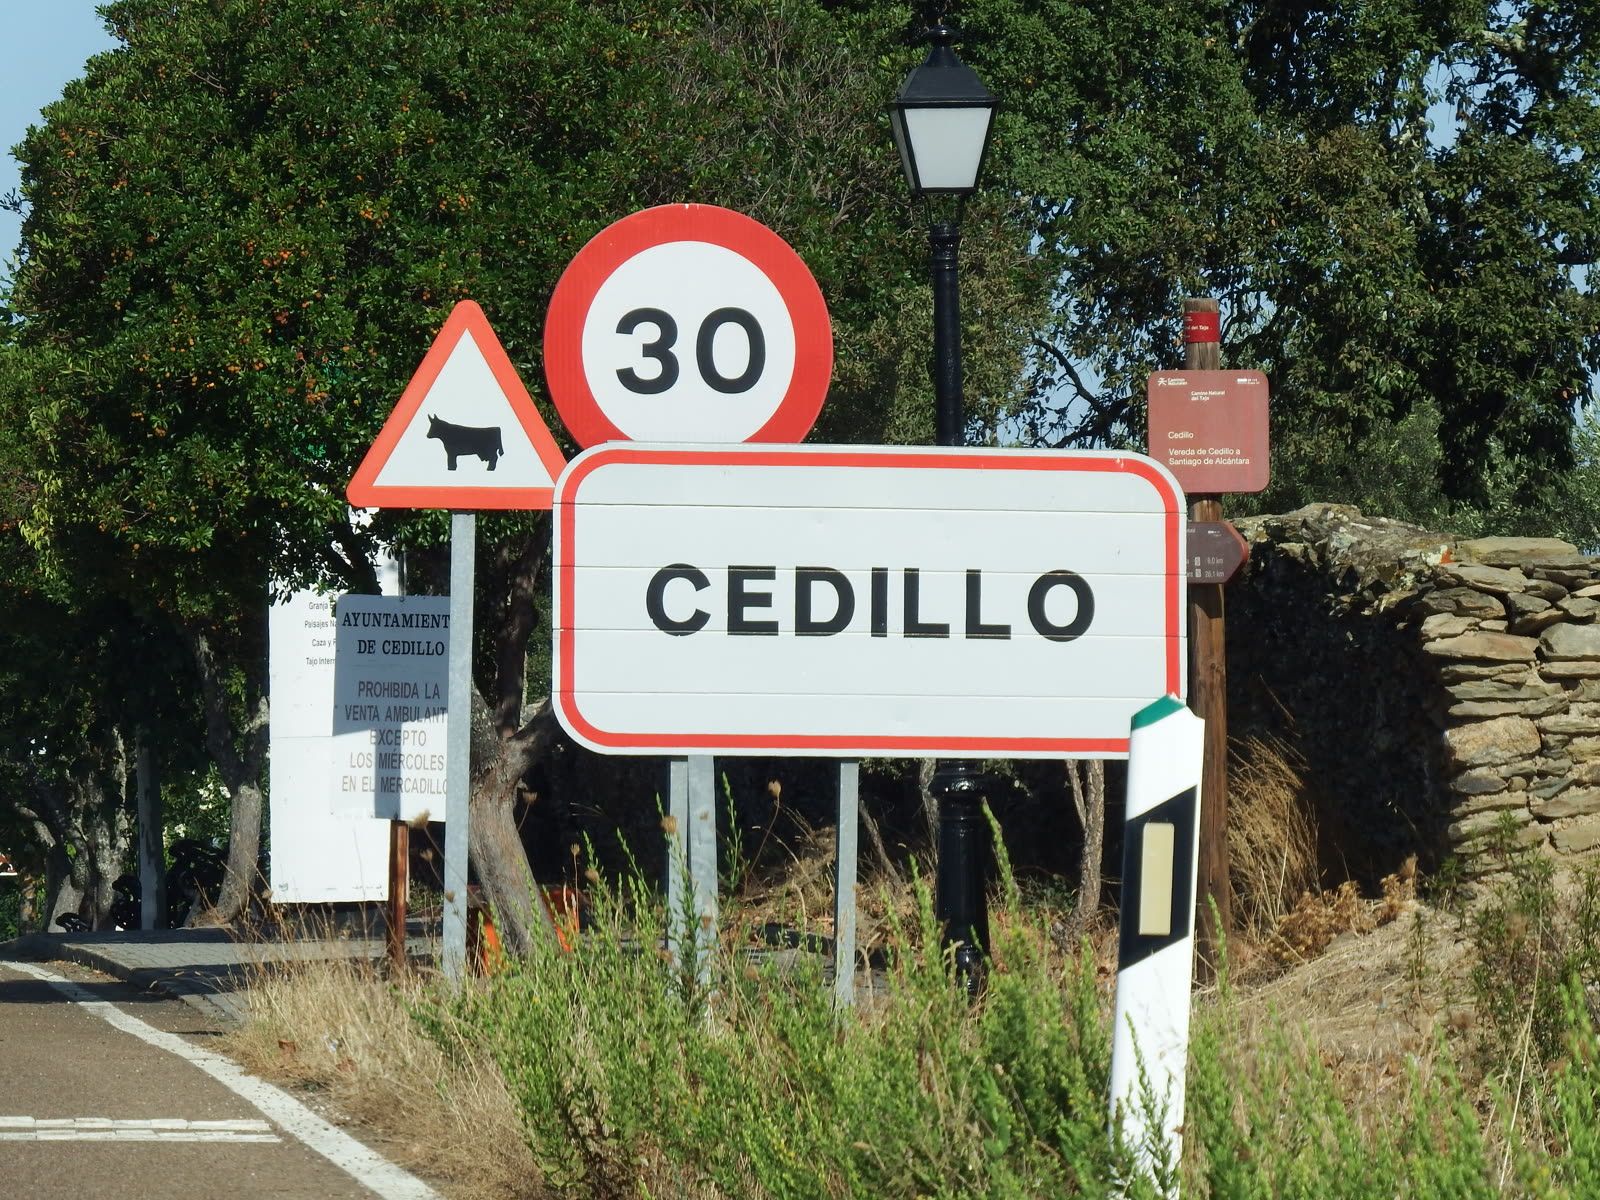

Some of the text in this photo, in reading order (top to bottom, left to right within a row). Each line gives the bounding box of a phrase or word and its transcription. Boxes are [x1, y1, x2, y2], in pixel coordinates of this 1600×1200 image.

[616, 307, 766, 395] 30
[1168, 431, 1194, 439] Cedillo
[1168, 447, 1195, 456] Vereda
[1197, 447, 1207, 455] de
[1208, 447, 1234, 455] Cedillo
[1169, 456, 1250, 466] Santiago de Alcántara
[308, 601, 329, 611] Granja
[646, 563, 1095, 642] CEDILLO
[304, 620, 329, 630] Paisajes
[312, 638, 326, 647] Caza
[357, 639, 445, 656] DE CEDILLO
[306, 657, 318, 666] Tajo
[358, 680, 440, 699] PROHIBIDA LA
[345, 704, 380, 721] VENTA
[369, 729, 427, 747] EXCEPTO
[350, 748, 445, 771] LOS MIÉRCOLES
[342, 775, 357, 793] EN
[361, 776, 376, 793] EL
